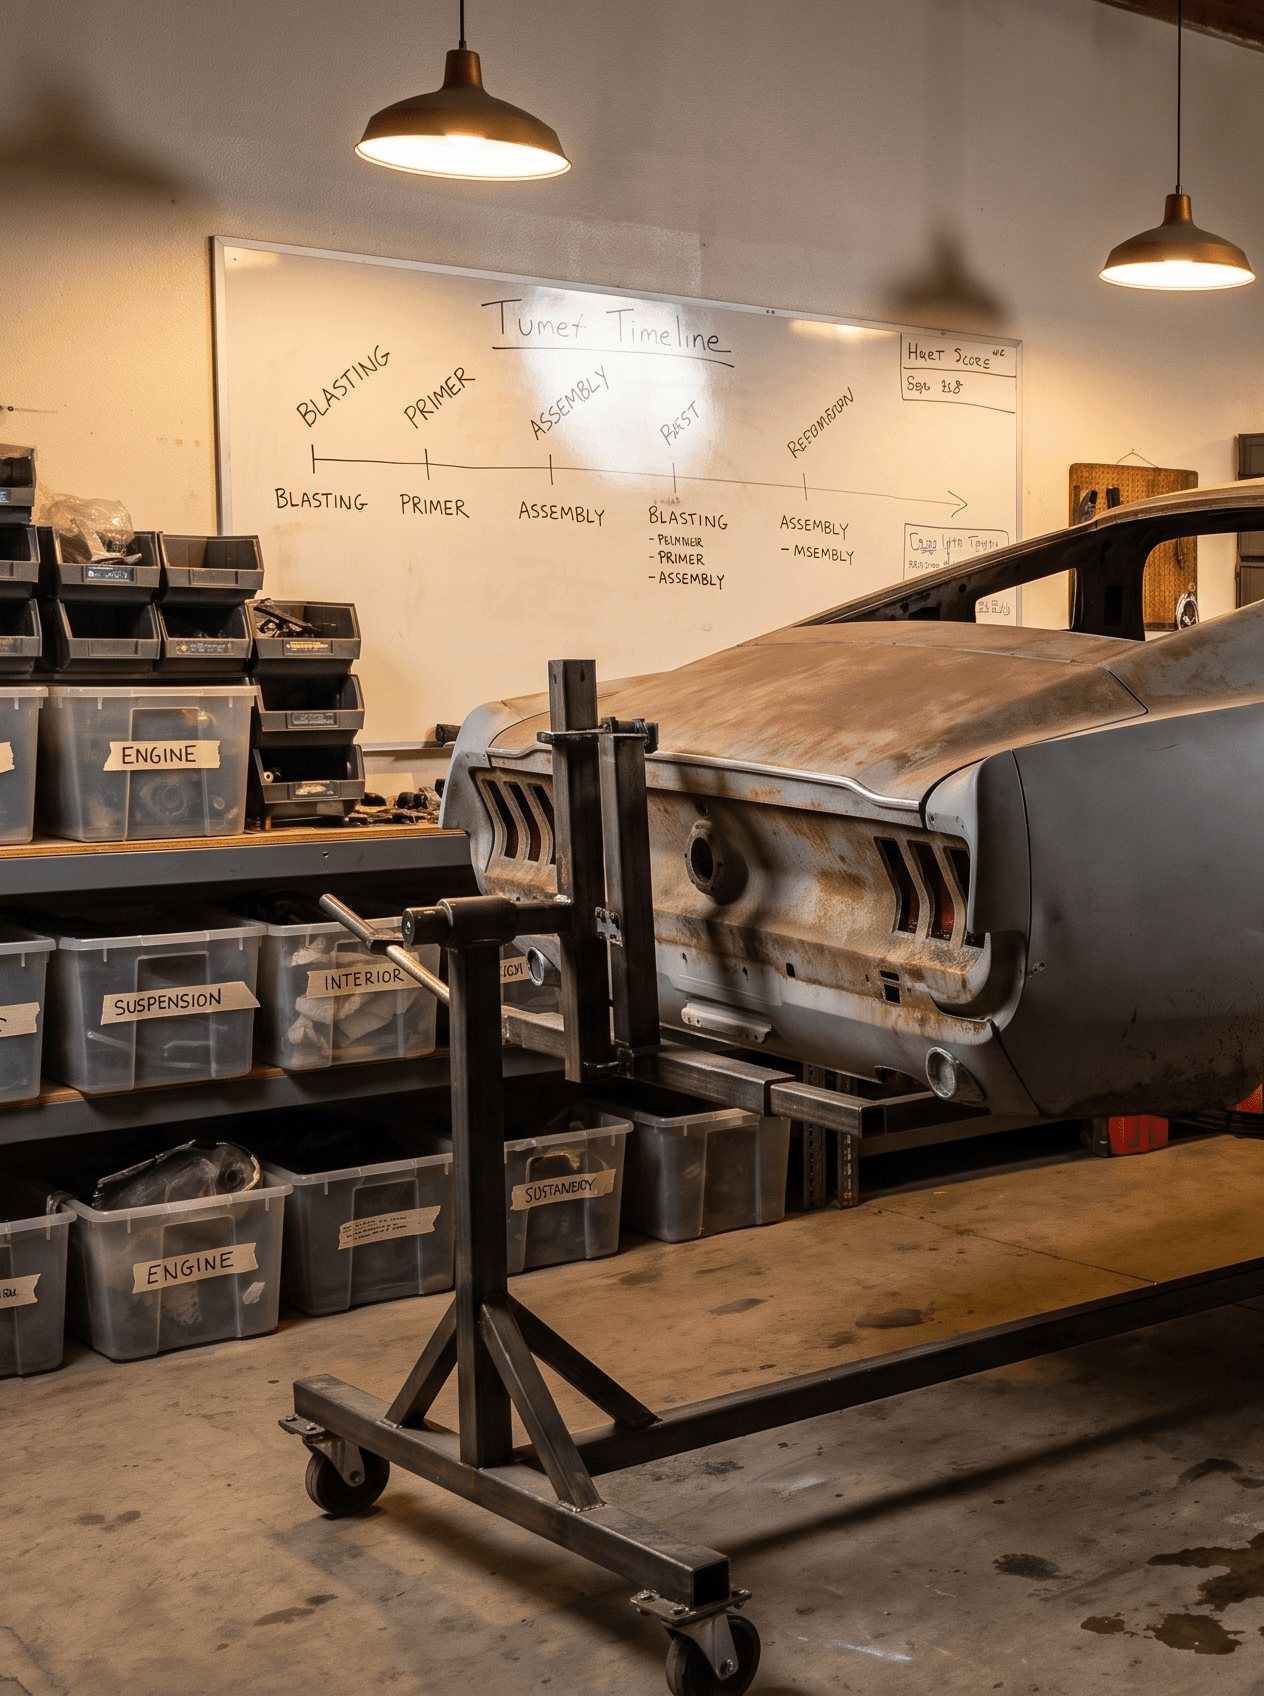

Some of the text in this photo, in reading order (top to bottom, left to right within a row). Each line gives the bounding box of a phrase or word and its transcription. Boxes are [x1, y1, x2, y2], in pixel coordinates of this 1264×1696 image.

[606, 308, 732, 353] Timeline
[296, 345, 390, 427] BLASTING
[404, 367, 475, 429] PRIMER
[530, 366, 609, 441] ASSEMBLY
[275, 488, 368, 510] BLASTING
[400, 494, 469, 518] PRIMER
[519, 501, 604, 526] ASSEMBLY
[648, 506, 728, 530] BLASTING
[780, 515, 848, 540] ASSEMBLY
[658, 551, 705, 565] PRIMER
[659, 571, 724, 590] ASSEMBLY
[123, 745, 196, 764] ENGINE
[324, 968, 404, 991] INTERIOR
[114, 988, 222, 1016] SUSPENSION
[148, 1251, 233, 1284] ENGINE
